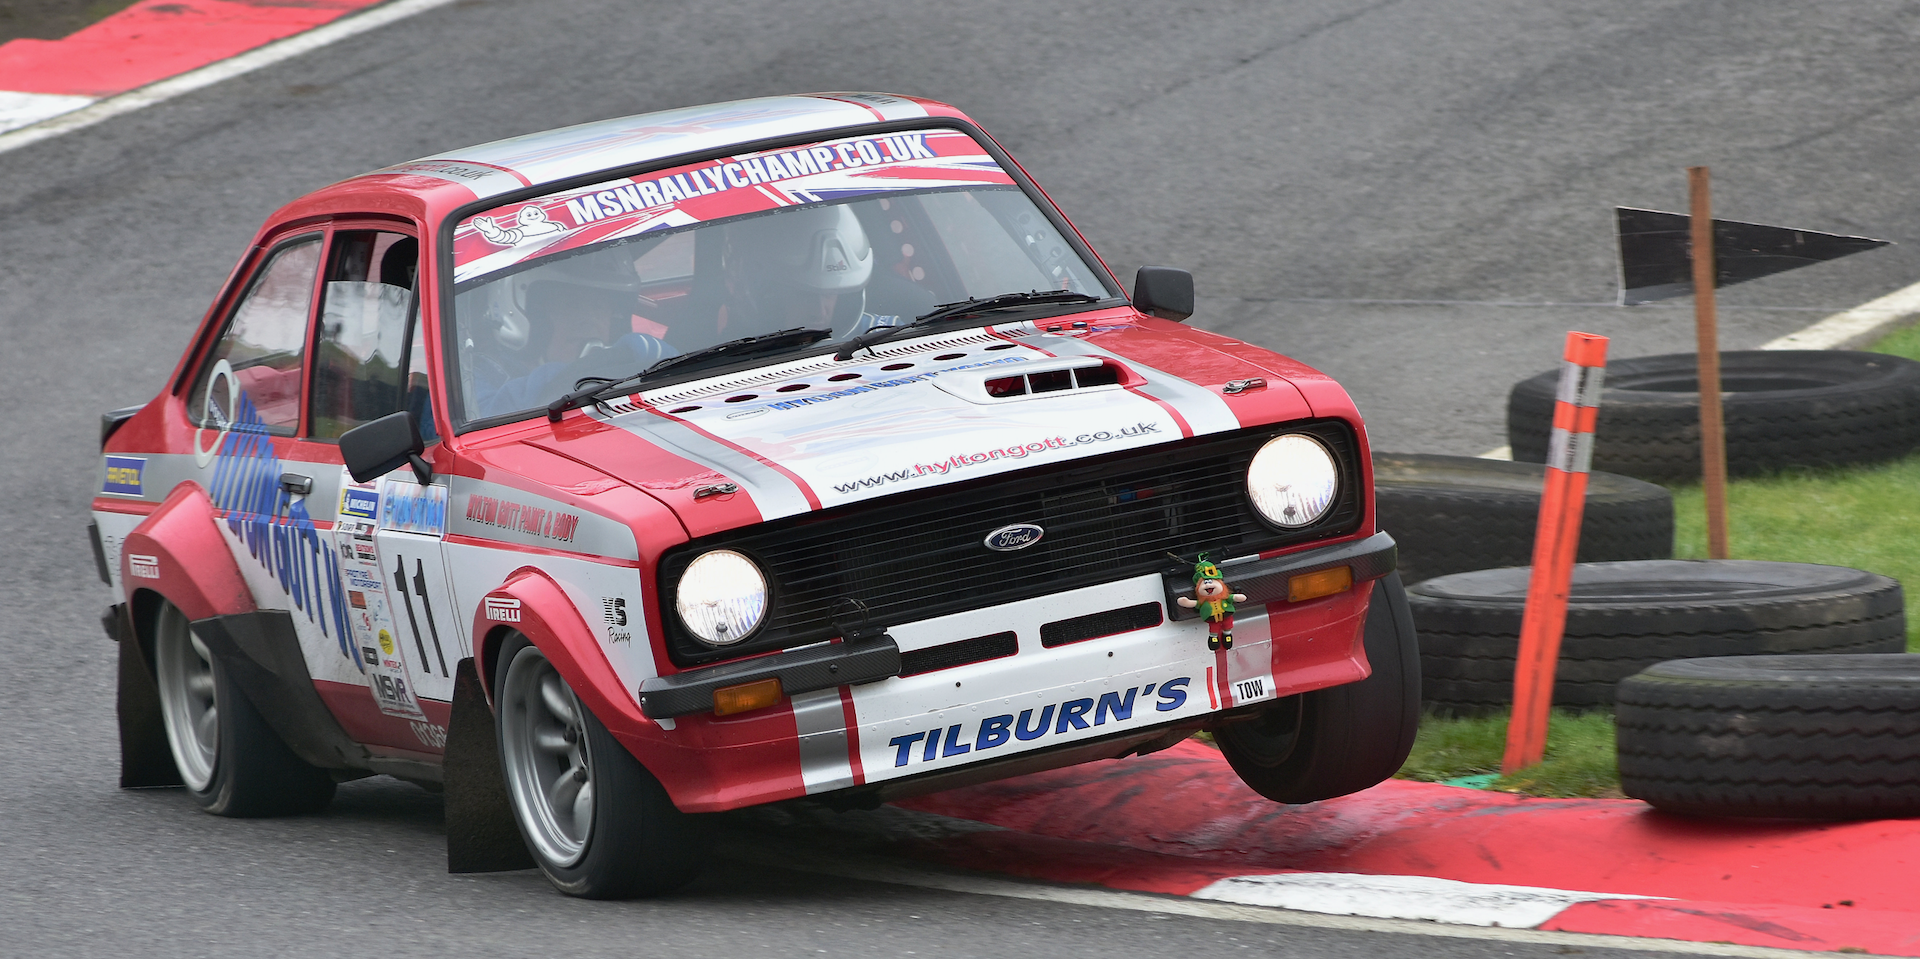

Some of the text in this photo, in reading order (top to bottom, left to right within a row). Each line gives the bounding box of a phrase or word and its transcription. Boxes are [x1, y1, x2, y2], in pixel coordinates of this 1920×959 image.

[565, 134, 936, 225] MSNRALLYCHAMP.CO.UK
[832, 421, 1162, 494] www.hyltongott.co.uk
[350, 498, 376, 511] MICHELIN
[466, 494, 499, 526] HYLTON
[497, 500, 521, 531] GOTT
[518, 504, 545, 536] PAINT
[543, 511, 553, 539] &
[552, 512, 579, 543] BODY
[999, 528, 1032, 547] Ford
[128, 554, 159, 579] PIRELLI
[393, 554, 449, 678] 11
[485, 597, 521, 623] PIRELLI
[607, 626, 631, 648] Racing
[372, 673, 411, 704] MSVR
[1235, 678, 1264, 702] TOW
[888, 677, 1191, 768] TILBURN'S
